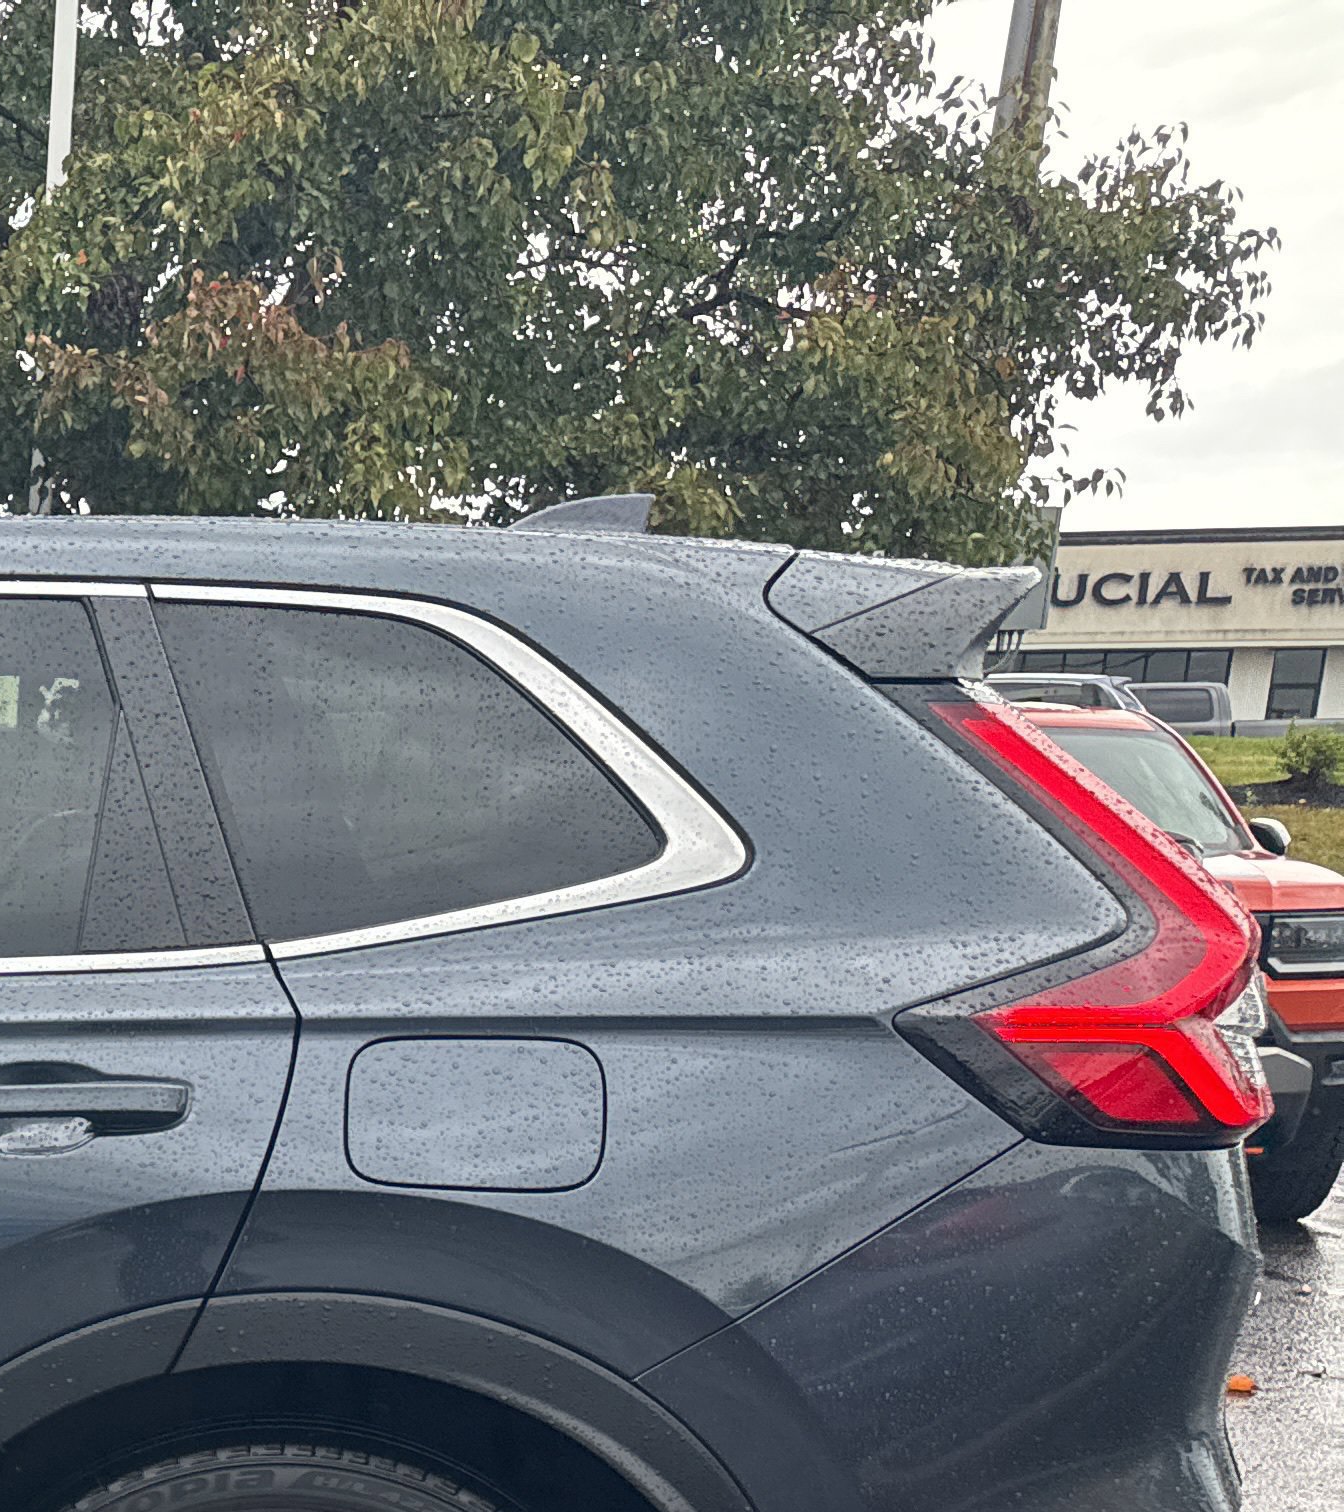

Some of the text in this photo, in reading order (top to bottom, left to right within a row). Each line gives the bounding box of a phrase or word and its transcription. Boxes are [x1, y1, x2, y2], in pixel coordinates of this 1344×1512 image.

[1051, 570, 1233, 607] UCIAL
[1243, 566, 1339, 585] TAX AND
